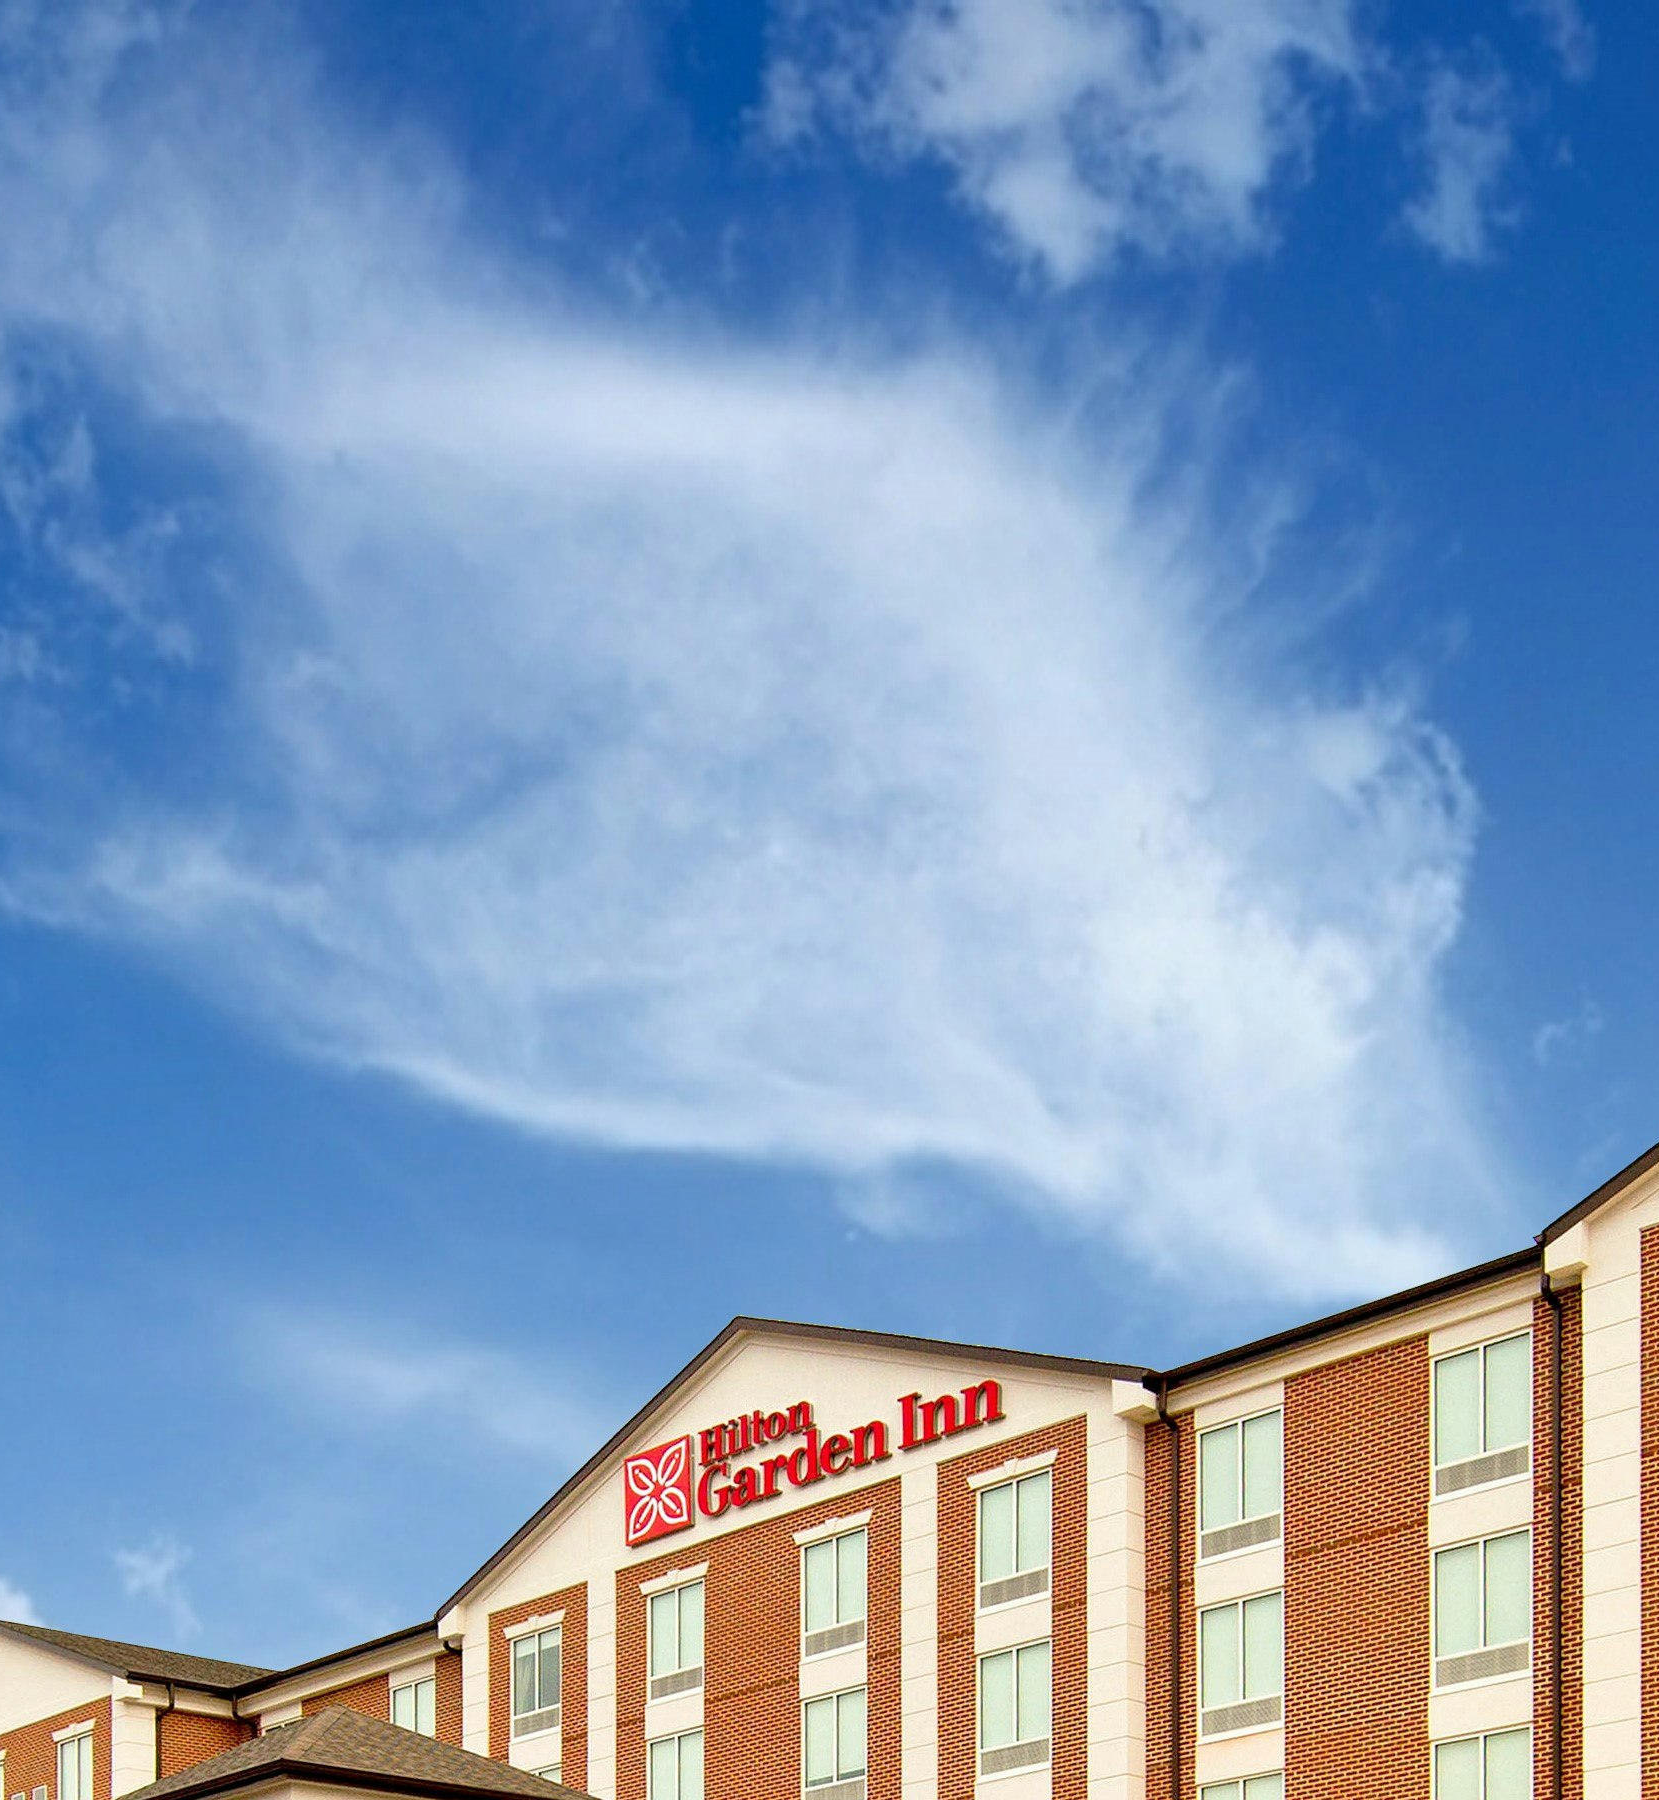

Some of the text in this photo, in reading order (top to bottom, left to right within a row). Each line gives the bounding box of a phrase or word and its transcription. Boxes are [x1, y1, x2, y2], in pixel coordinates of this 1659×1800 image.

[697, 1379, 1006, 1517] Garden Inn
[698, 1401, 815, 1467] Hilton
